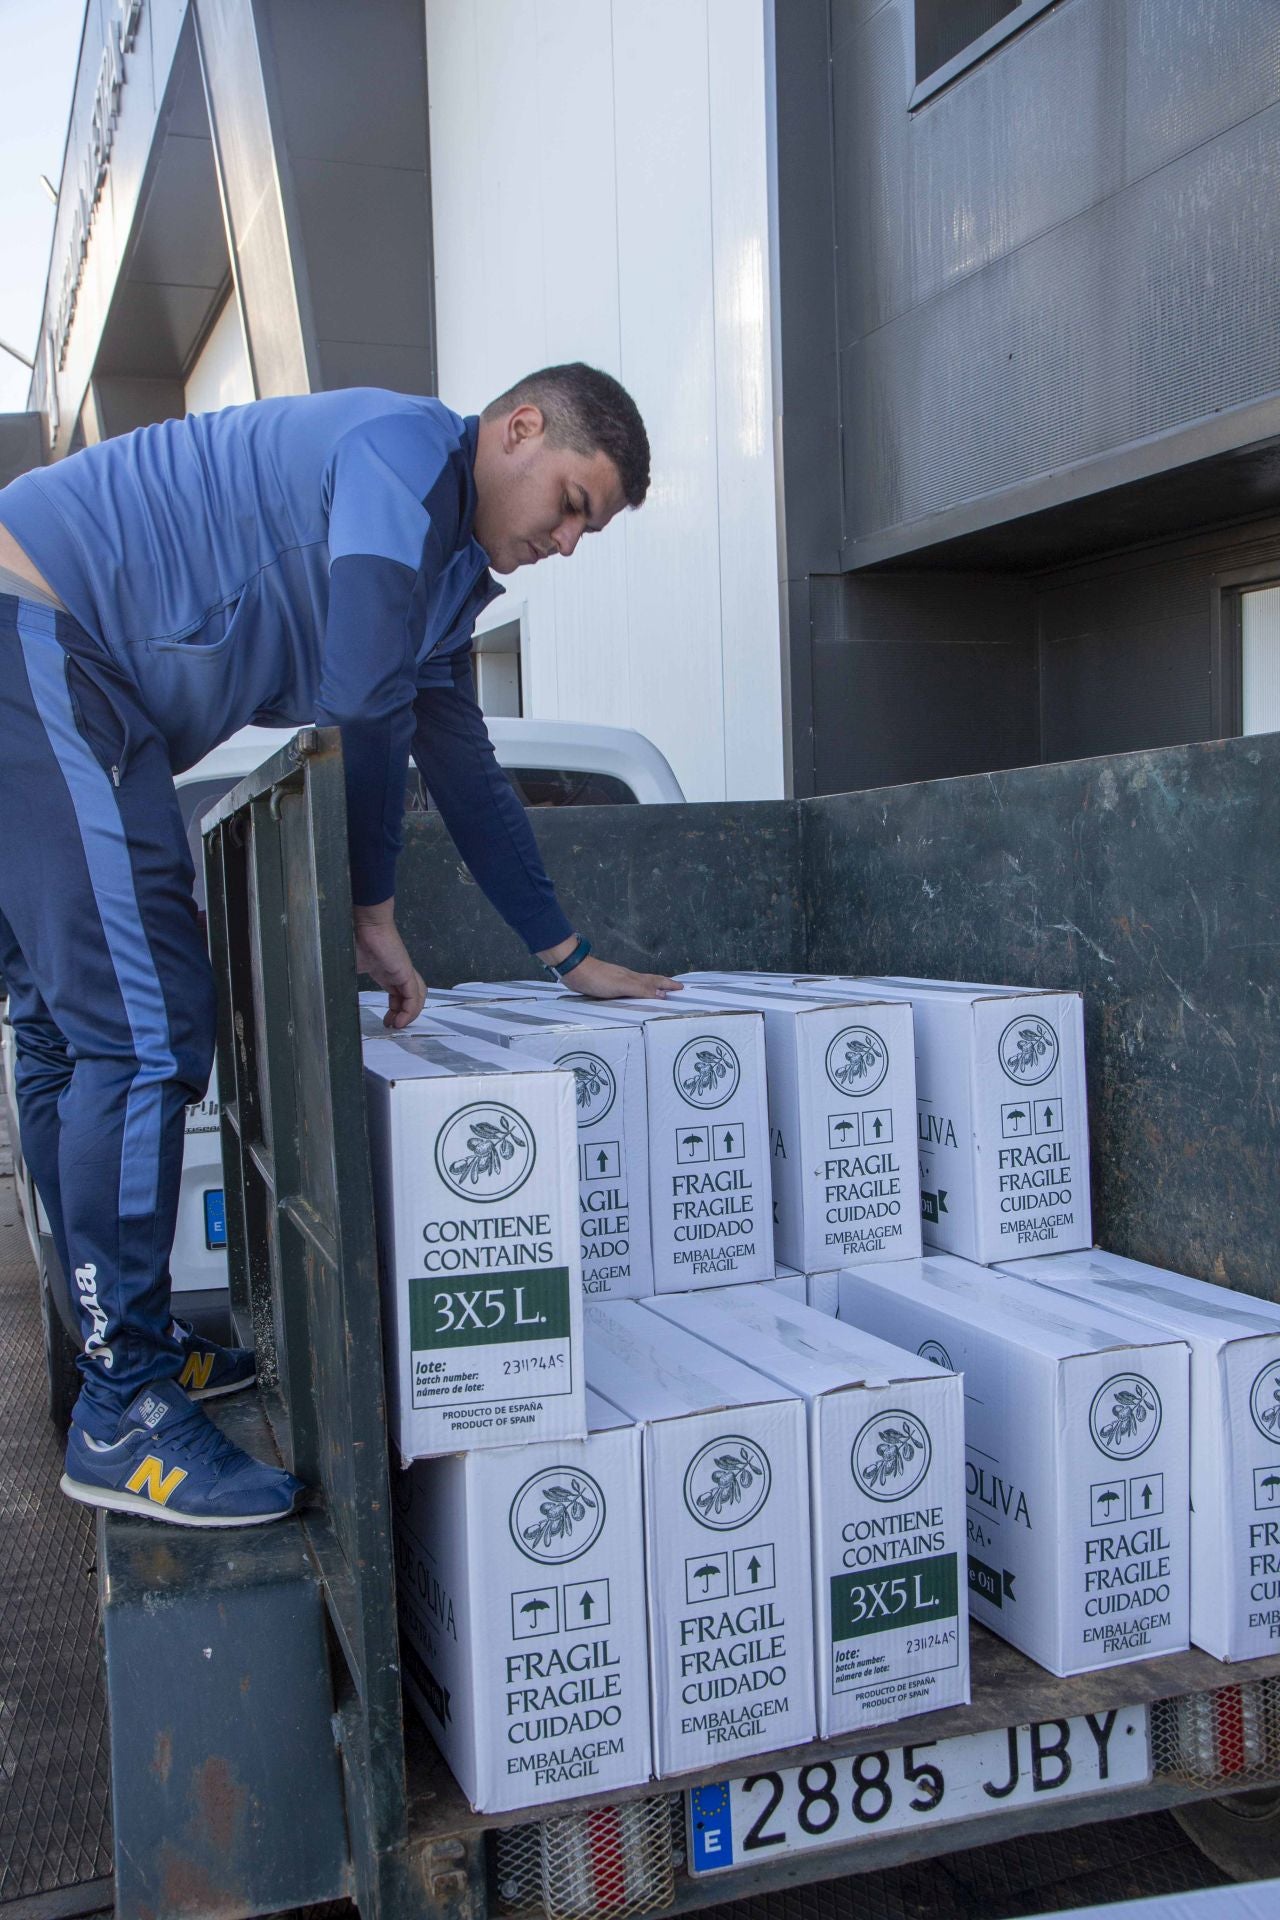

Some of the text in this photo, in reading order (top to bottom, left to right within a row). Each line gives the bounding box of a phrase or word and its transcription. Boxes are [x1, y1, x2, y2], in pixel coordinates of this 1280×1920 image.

[918, 1113, 958, 1148] LIVA
[825, 1153, 900, 1180] FRAGIL
[998, 1142, 1070, 1169] FRAGIL
[672, 1169, 752, 1196] FRAGIL
[826, 1178, 900, 1203] FRAGILE
[999, 1166, 1072, 1192] FRAGILE
[579, 1189, 628, 1212] GIL
[672, 1195, 753, 1220] FRAGILE
[826, 1200, 900, 1223] CUIDADO
[1000, 1190, 1072, 1212] CUIDADO
[214, 1221, 223, 1231] E
[423, 1214, 551, 1243] CONTIENE
[581, 1216, 630, 1237] GILE
[674, 1218, 754, 1242] CUIDADO
[825, 1224, 902, 1245] EMBALAGEM
[1000, 1213, 1074, 1234] EMBALAGEM
[1018, 1228, 1058, 1244] FRAGIL
[424, 1242, 553, 1271] CONTAINS
[581, 1240, 630, 1260] DADO
[674, 1243, 756, 1264] EMBALAGEM
[844, 1239, 886, 1254] FRAGIL
[582, 1265, 630, 1282] LAGEM
[693, 1259, 738, 1274] FRAGIL
[582, 1280, 611, 1294] AGIL
[433, 1287, 547, 1332] 3X5 L.
[416, 1361, 446, 1374] lote:
[416, 1372, 478, 1386] batch number:
[416, 1383, 484, 1397] número de lote:
[148, 1407, 165, 1424] 500
[443, 1408, 492, 1420] PRODUCTO
[509, 1402, 543, 1413] ESPAÑA
[452, 1415, 536, 1430] PRODUCT OF SPAIN
[125, 1454, 188, 1505] N
[842, 1507, 944, 1543] CONTIENE
[842, 1532, 944, 1568] CONTAINS
[1084, 1527, 1170, 1564] FRAGIL
[978, 1572, 994, 1595] Oil
[1085, 1556, 1170, 1592] FRAGILE
[418, 1562, 458, 1641] OLIVA
[850, 1574, 940, 1622] 3X5 L.
[1085, 1584, 1170, 1617] CUIDADO
[680, 1602, 784, 1646] FRAGIL
[1084, 1612, 1170, 1643] EMBALAGEM
[1103, 1632, 1151, 1653] FRAGIL
[505, 1640, 620, 1684] FRAGIL
[680, 1635, 786, 1677] FRAGILE
[836, 1649, 860, 1662] lote:
[836, 1656, 886, 1672] batch number:
[682, 1666, 786, 1704] CUIDADO
[836, 1665, 890, 1683] número de lote:
[506, 1674, 622, 1716] FRAGILE
[856, 1676, 936, 1700] PRODUCTO DE ESPAÑA
[862, 1696, 896, 1709] PRODUCT
[909, 1688, 929, 1698] SPAIN
[508, 1705, 622, 1744] CUIDADO
[681, 1697, 789, 1734] EMBALAGEM
[707, 1719, 766, 1745] FRAGIL
[507, 1738, 624, 1774] EMBALAGEM
[535, 1761, 599, 1786] FRAGIL
[704, 1708, 1118, 1853] E 2885 JBY
